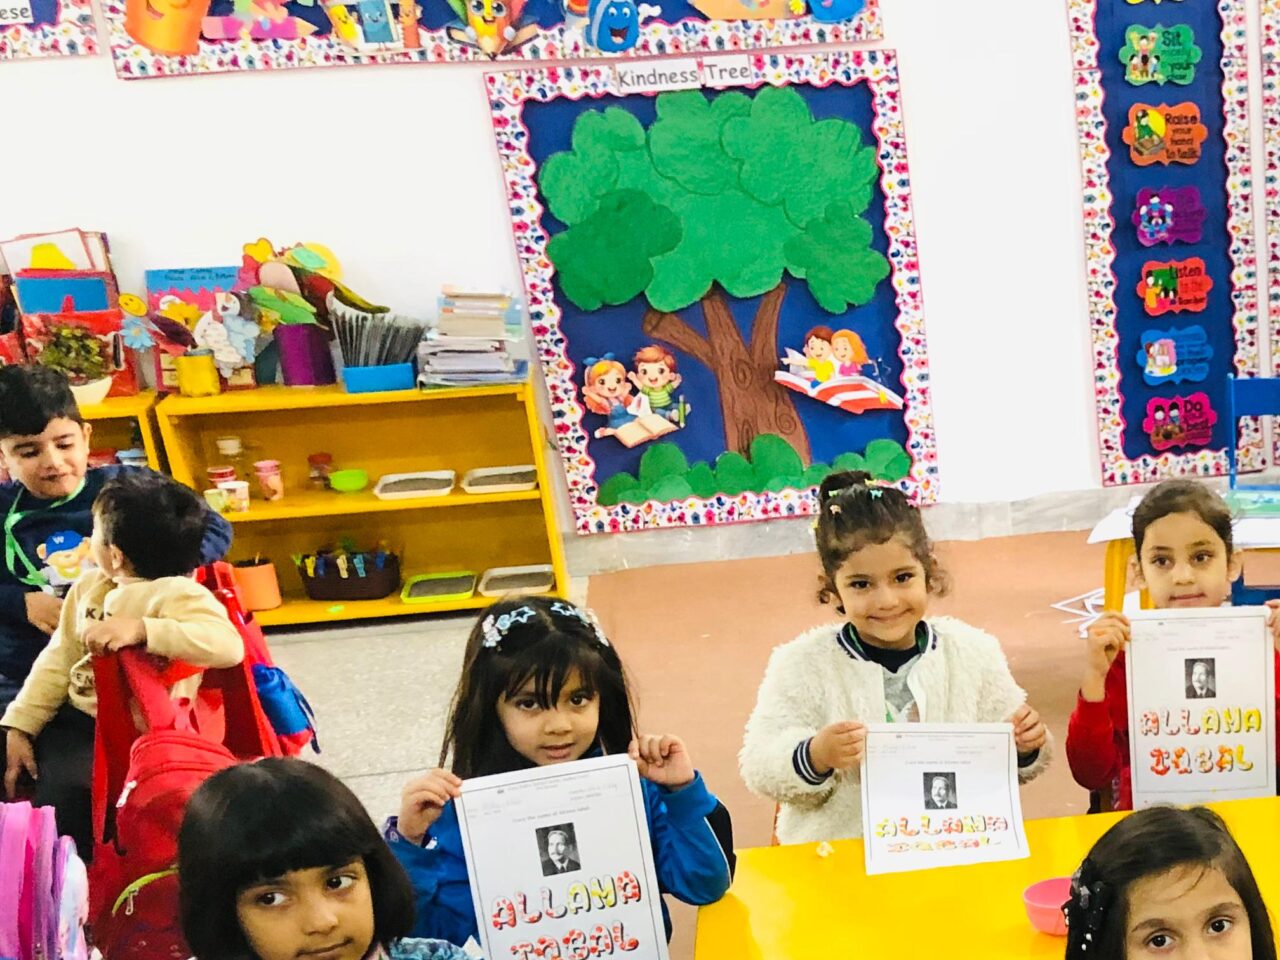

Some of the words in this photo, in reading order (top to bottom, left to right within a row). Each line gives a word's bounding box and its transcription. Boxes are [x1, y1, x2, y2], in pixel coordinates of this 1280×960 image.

[619, 67, 698, 87] Kindness
[704, 64, 750, 80] Tree
[1165, 113, 1198, 125] Raise
[1140, 706, 1262, 736] ALLAMA
[1150, 744, 1254, 776] IQBAL
[491, 870, 642, 930] ALLAMA
